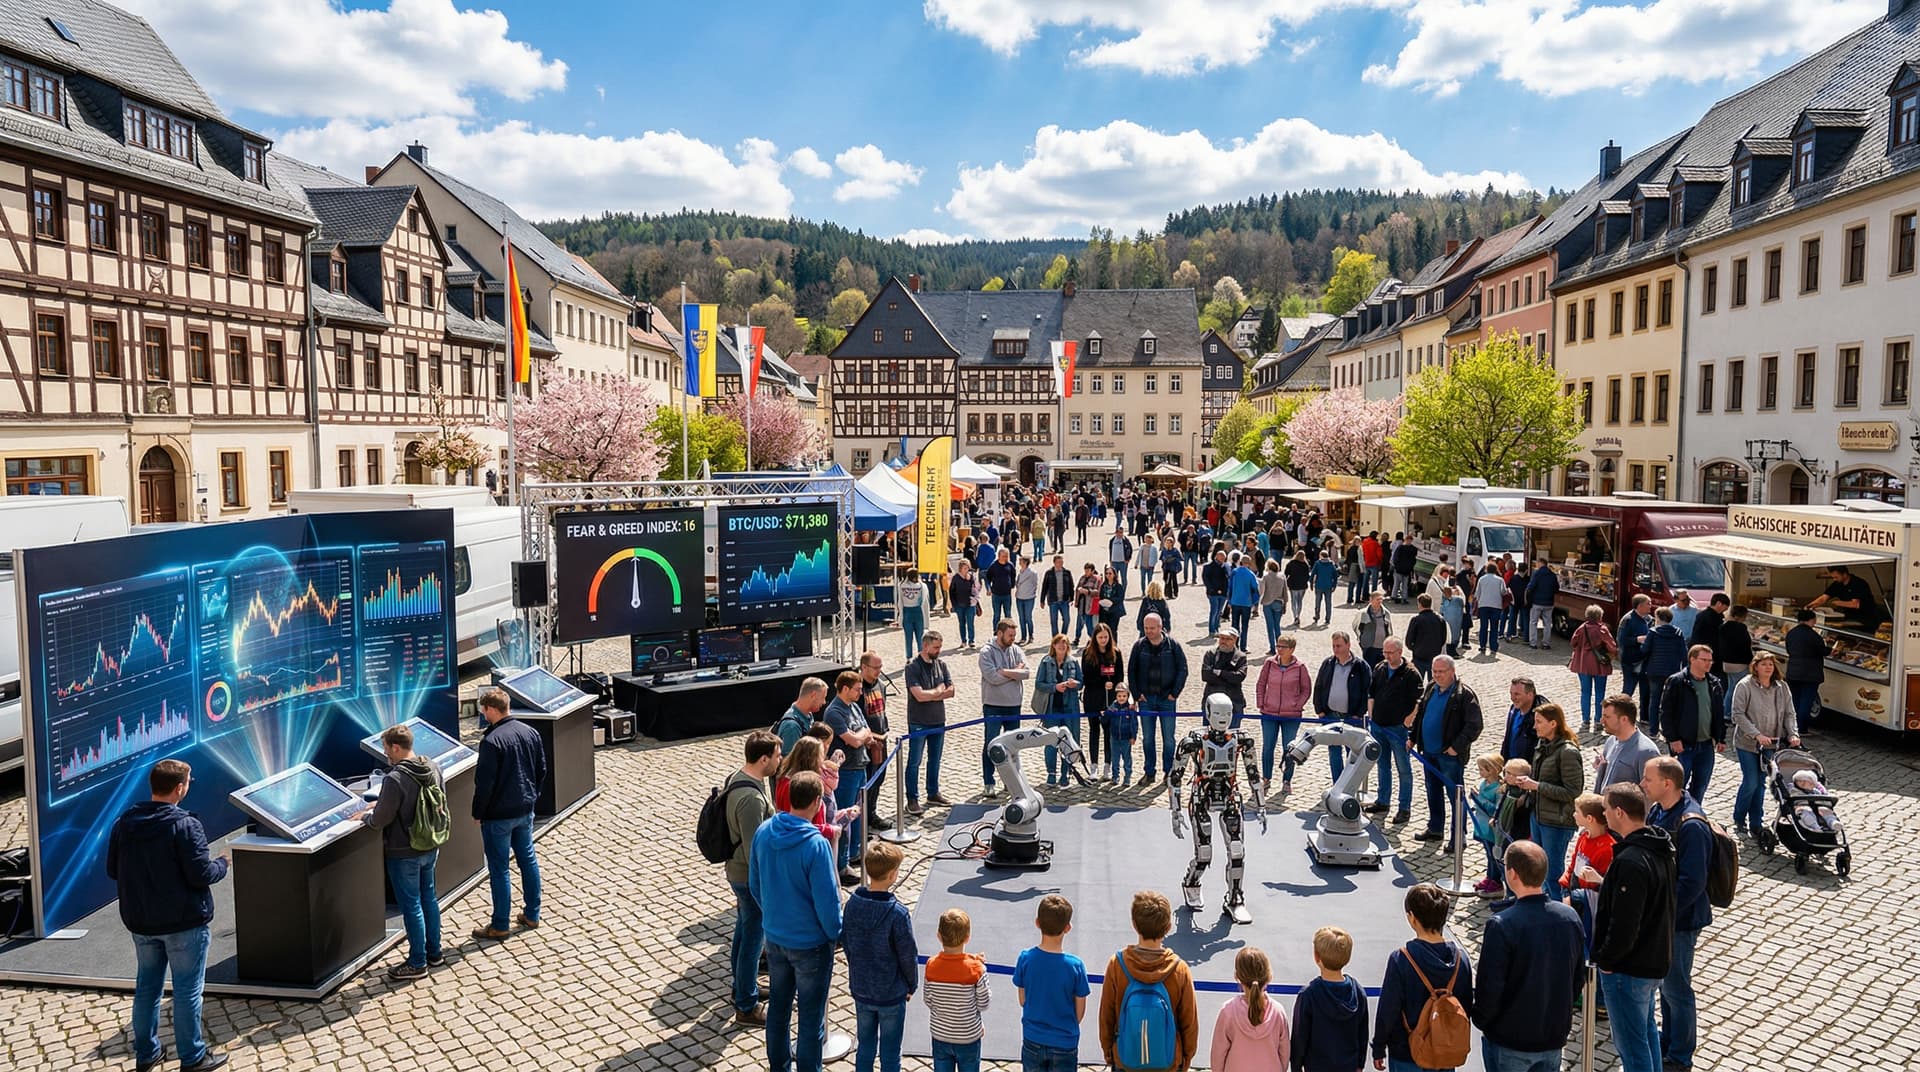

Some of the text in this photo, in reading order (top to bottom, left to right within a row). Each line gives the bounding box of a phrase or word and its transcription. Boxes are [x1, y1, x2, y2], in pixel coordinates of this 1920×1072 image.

[567, 519, 696, 538] FEAR & GREED INDEX: 16
[728, 513, 828, 531] BTC/USD: $71,380
[1734, 512, 1797, 535] SÄCHSISCHE
[1800, 521, 1896, 548] SPEZIALITÄTEN
